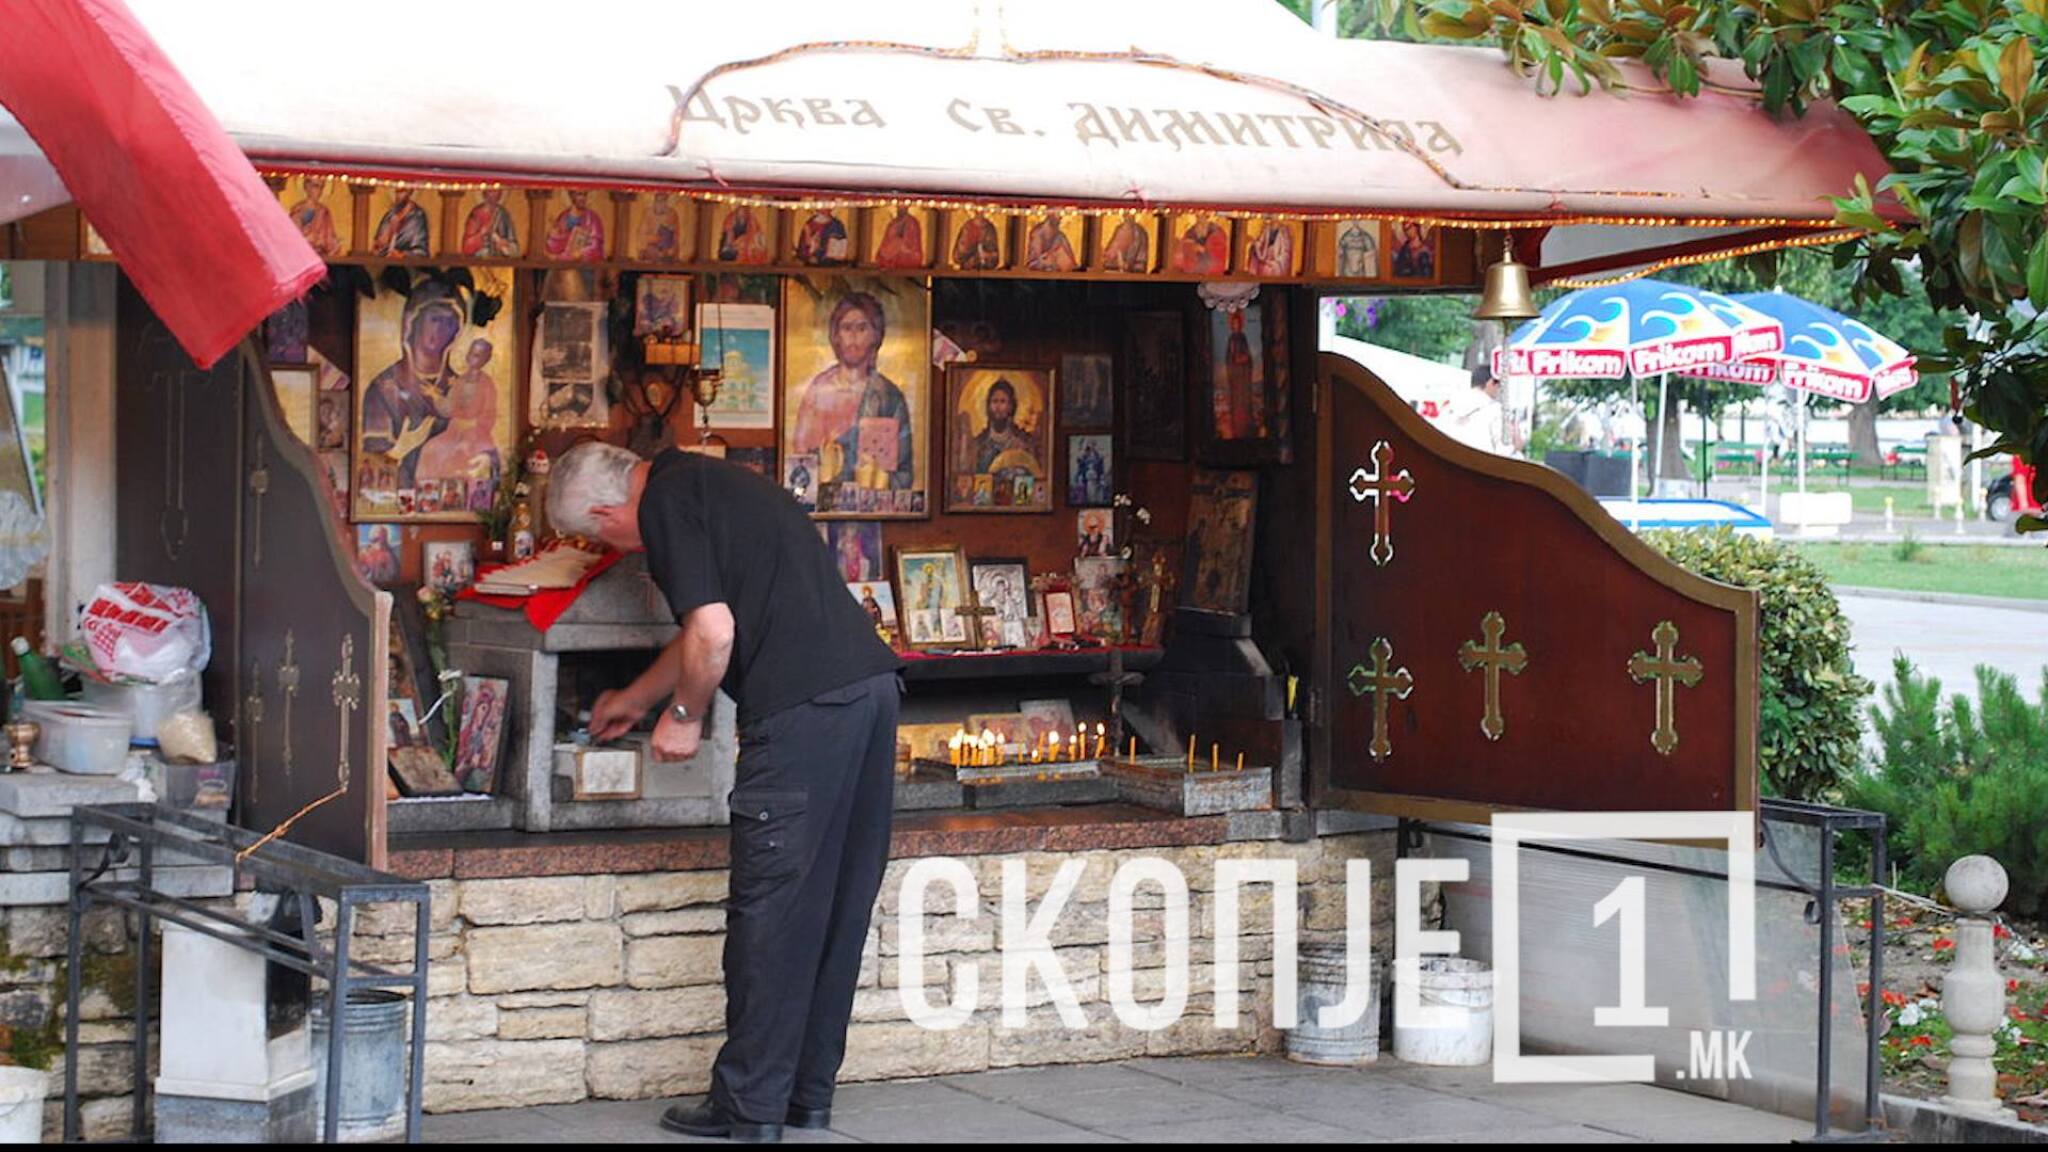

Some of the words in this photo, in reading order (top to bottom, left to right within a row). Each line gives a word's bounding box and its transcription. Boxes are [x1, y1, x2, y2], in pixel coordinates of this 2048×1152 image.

[1532, 350, 1621, 375] Frikom
[1635, 342, 1726, 374] Frikom
[1783, 361, 1864, 400] Frikom
